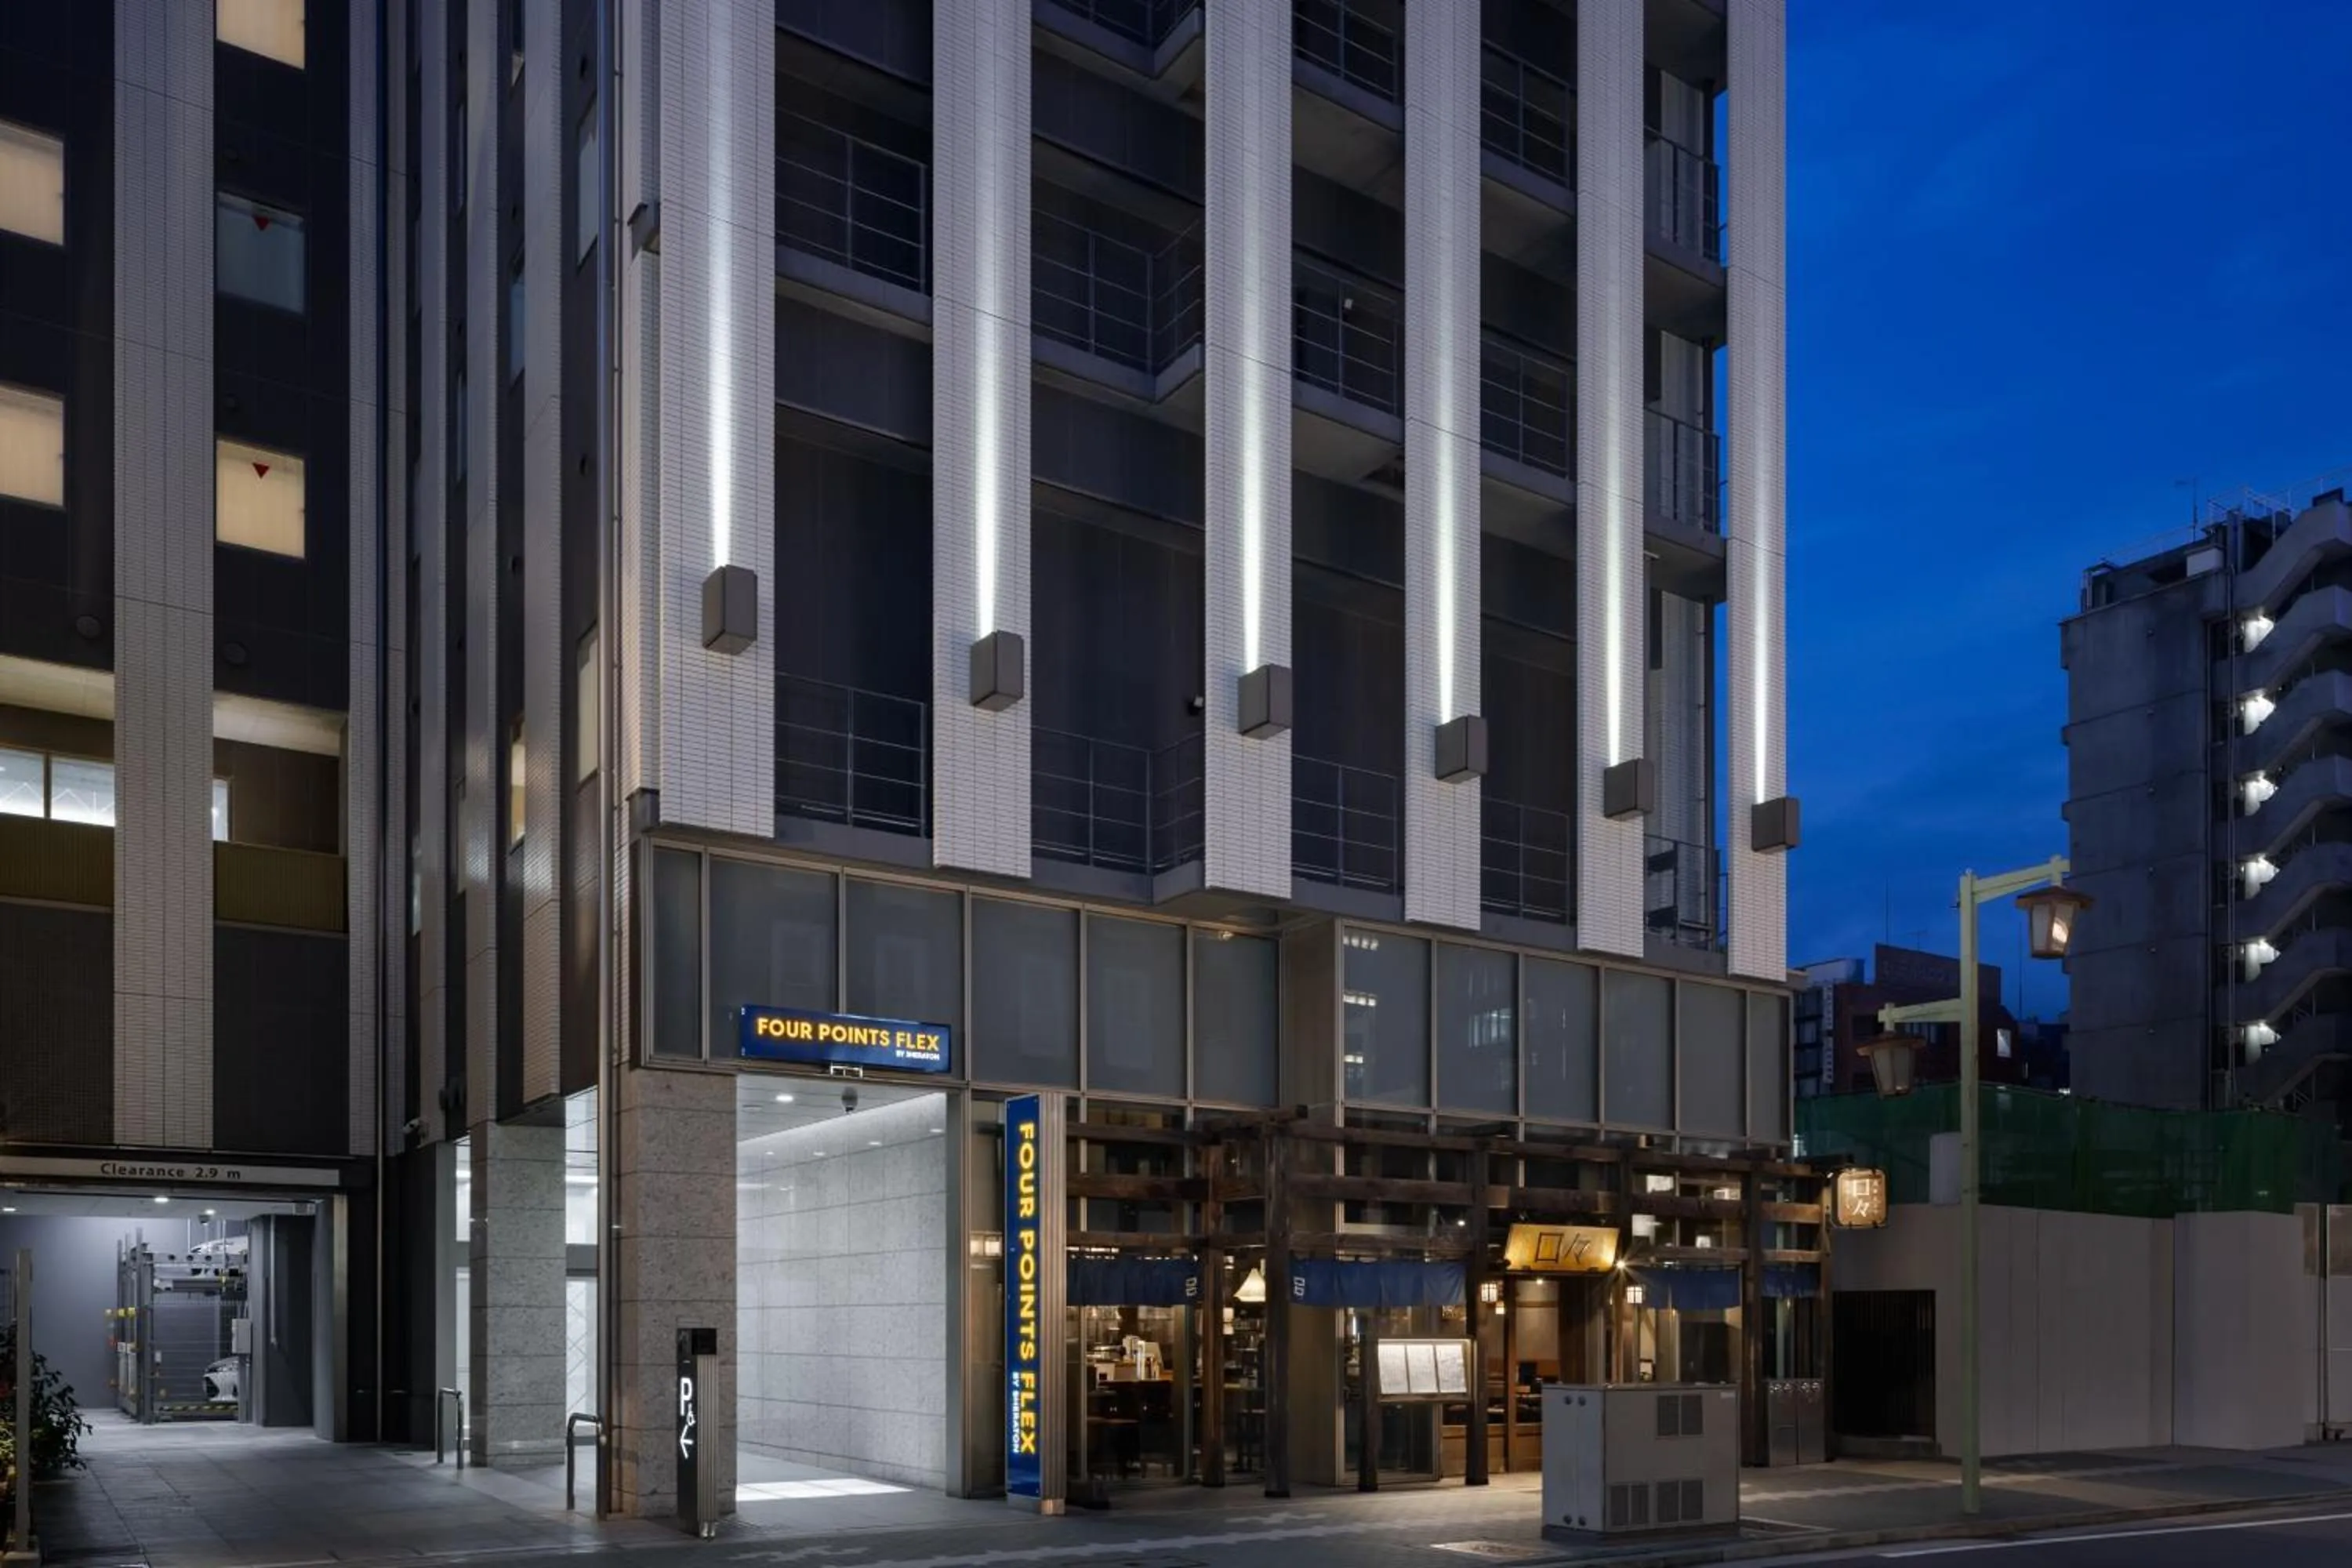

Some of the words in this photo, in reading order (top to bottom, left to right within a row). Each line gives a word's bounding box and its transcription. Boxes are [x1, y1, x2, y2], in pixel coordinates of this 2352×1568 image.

[757, 1018, 813, 1040] FOUR
[818, 1024, 890, 1047] POINTS
[896, 1032, 938, 1051] FLEX
[100, 1163, 184, 1178] Clearance
[195, 1167, 218, 1178] 2.9
[227, 1170, 241, 1179] m
[1019, 1123, 1035, 1218] FOUR
[1019, 1230, 1035, 1360] POINTS
[681, 1377, 693, 1416] P
[1012, 1372, 1020, 1387] BY
[1020, 1373, 1036, 1455] FLEX
